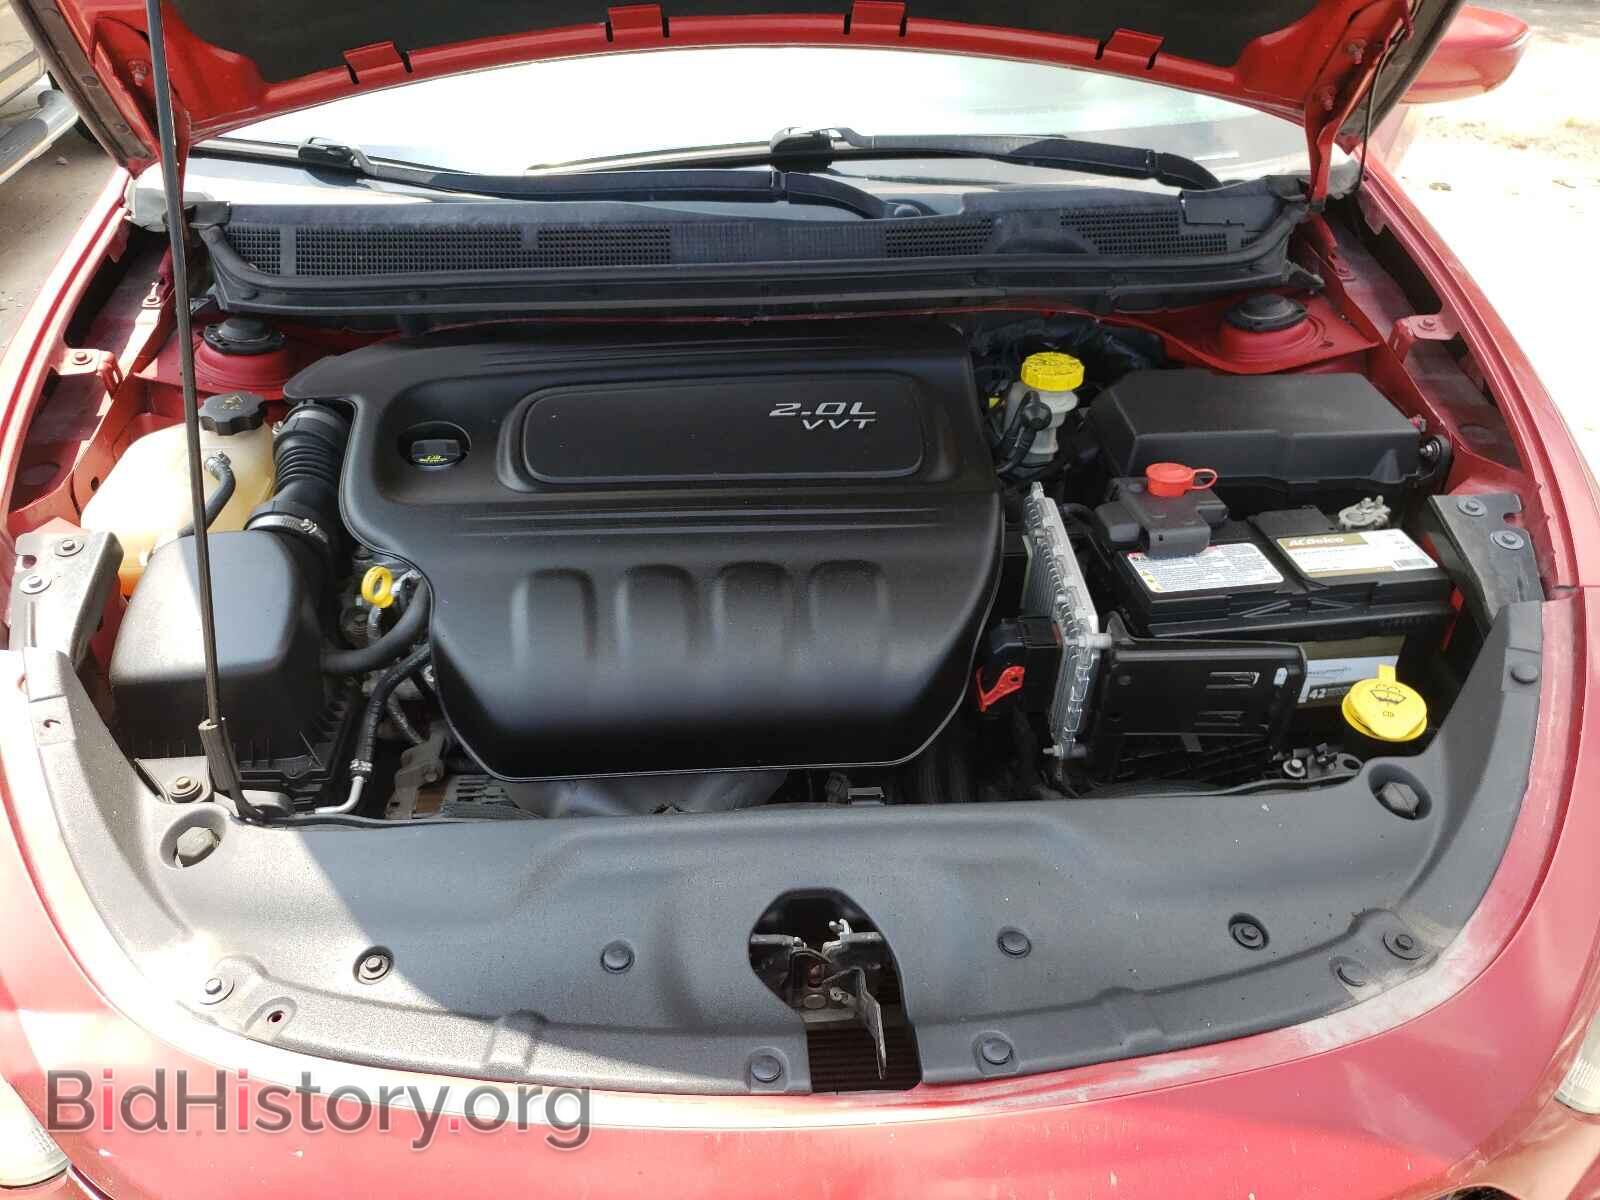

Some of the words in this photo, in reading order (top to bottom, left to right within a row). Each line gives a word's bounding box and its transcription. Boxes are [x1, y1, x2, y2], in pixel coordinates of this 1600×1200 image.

[769, 401, 877, 416] 2.0L
[802, 418, 877, 431] VVT
[1308, 688, 1327, 699] 42
